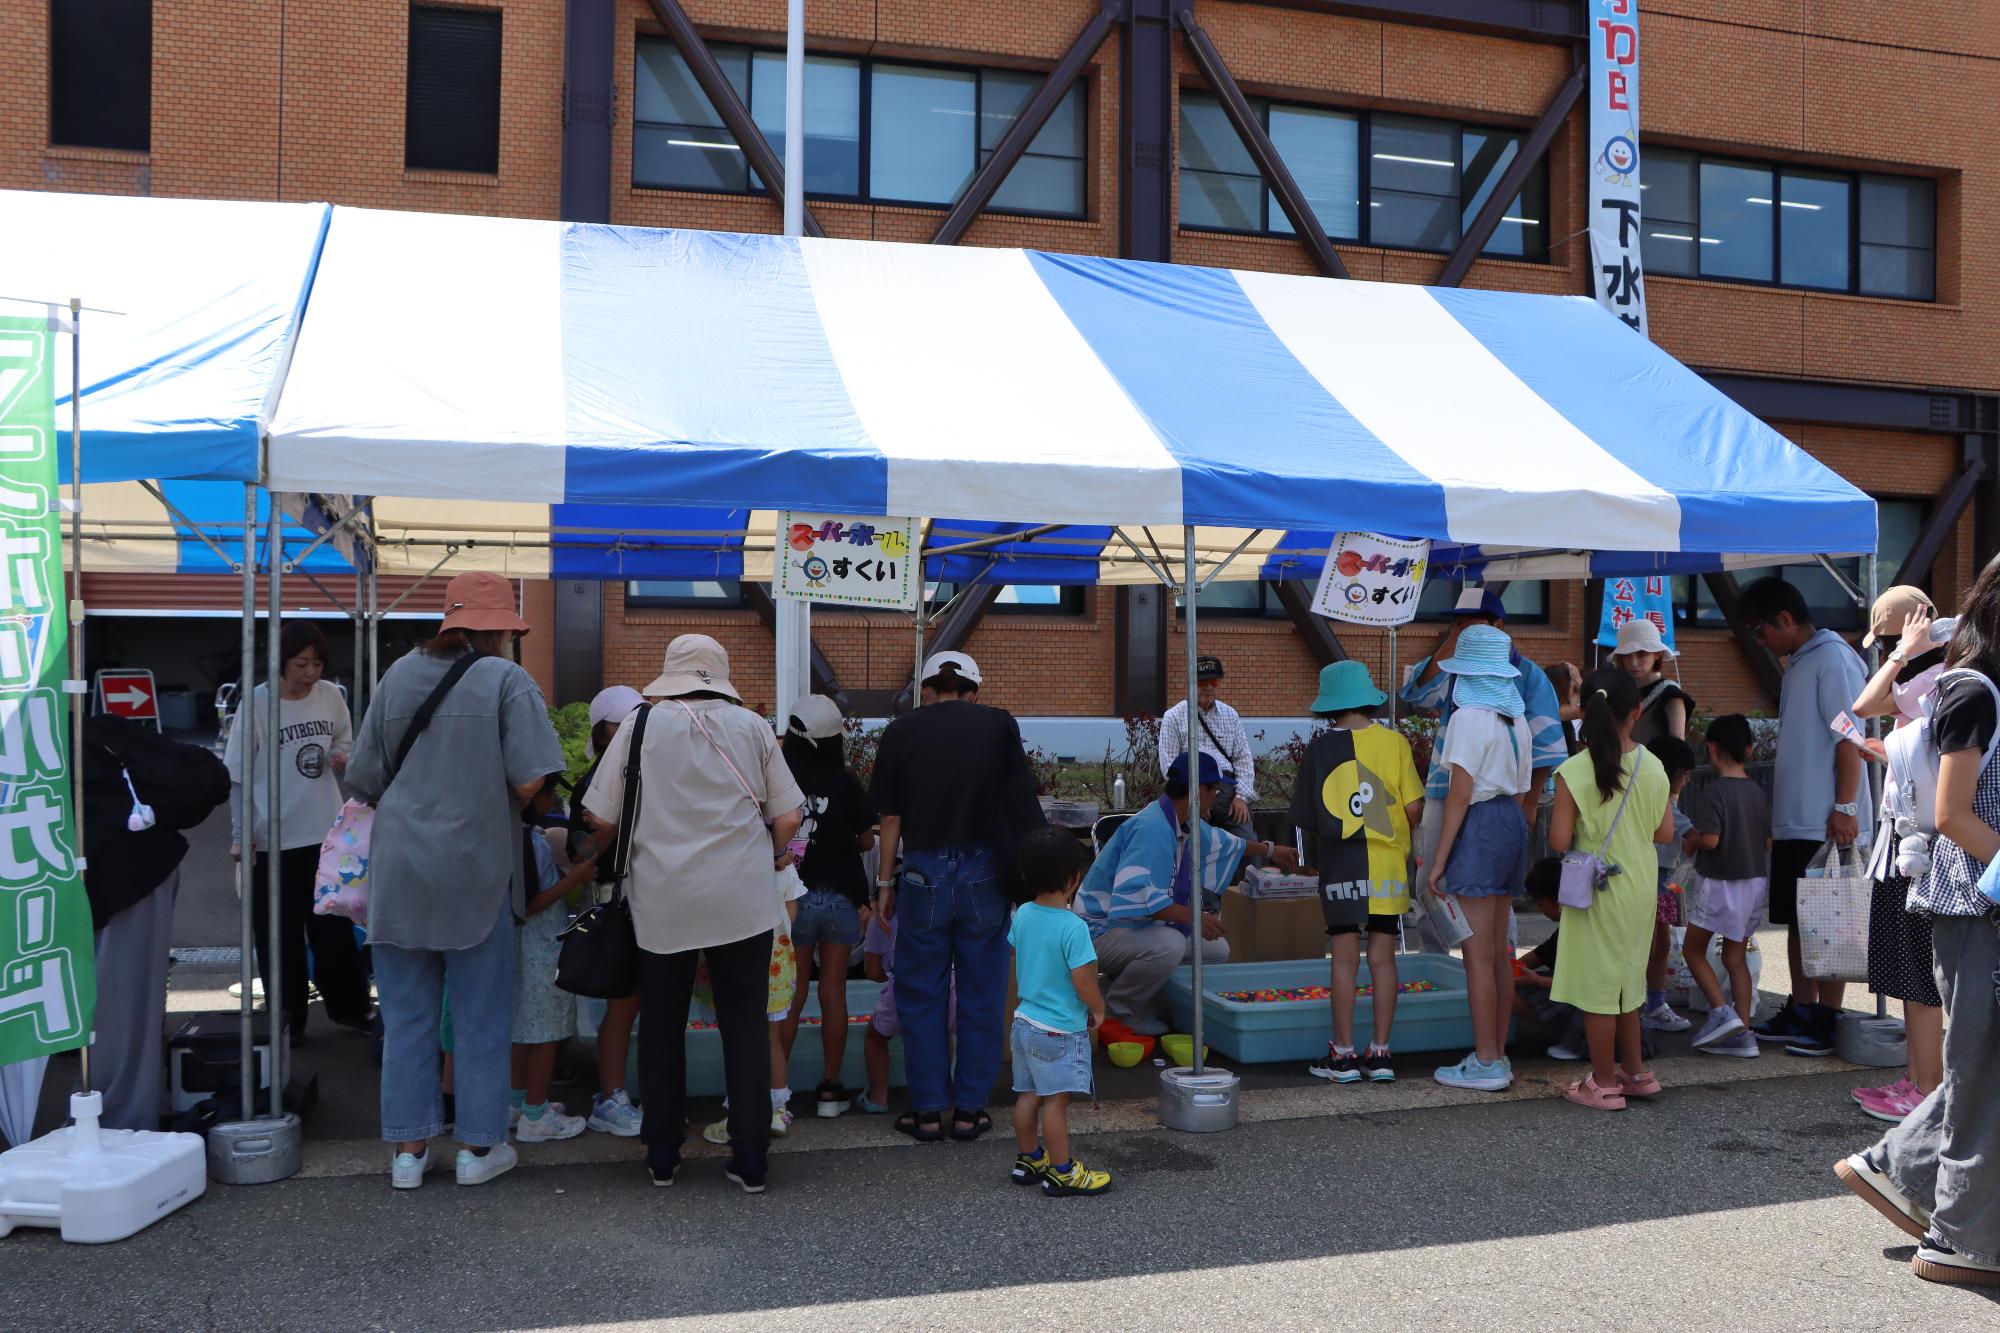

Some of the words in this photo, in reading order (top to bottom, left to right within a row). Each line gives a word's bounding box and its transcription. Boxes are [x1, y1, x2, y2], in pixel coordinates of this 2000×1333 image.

[792, 521, 905, 550] スーパーボール
[832, 556, 897, 582] すくい
[1371, 585, 1416, 605] すくい
[1612, 577, 1635, 629] 公社
